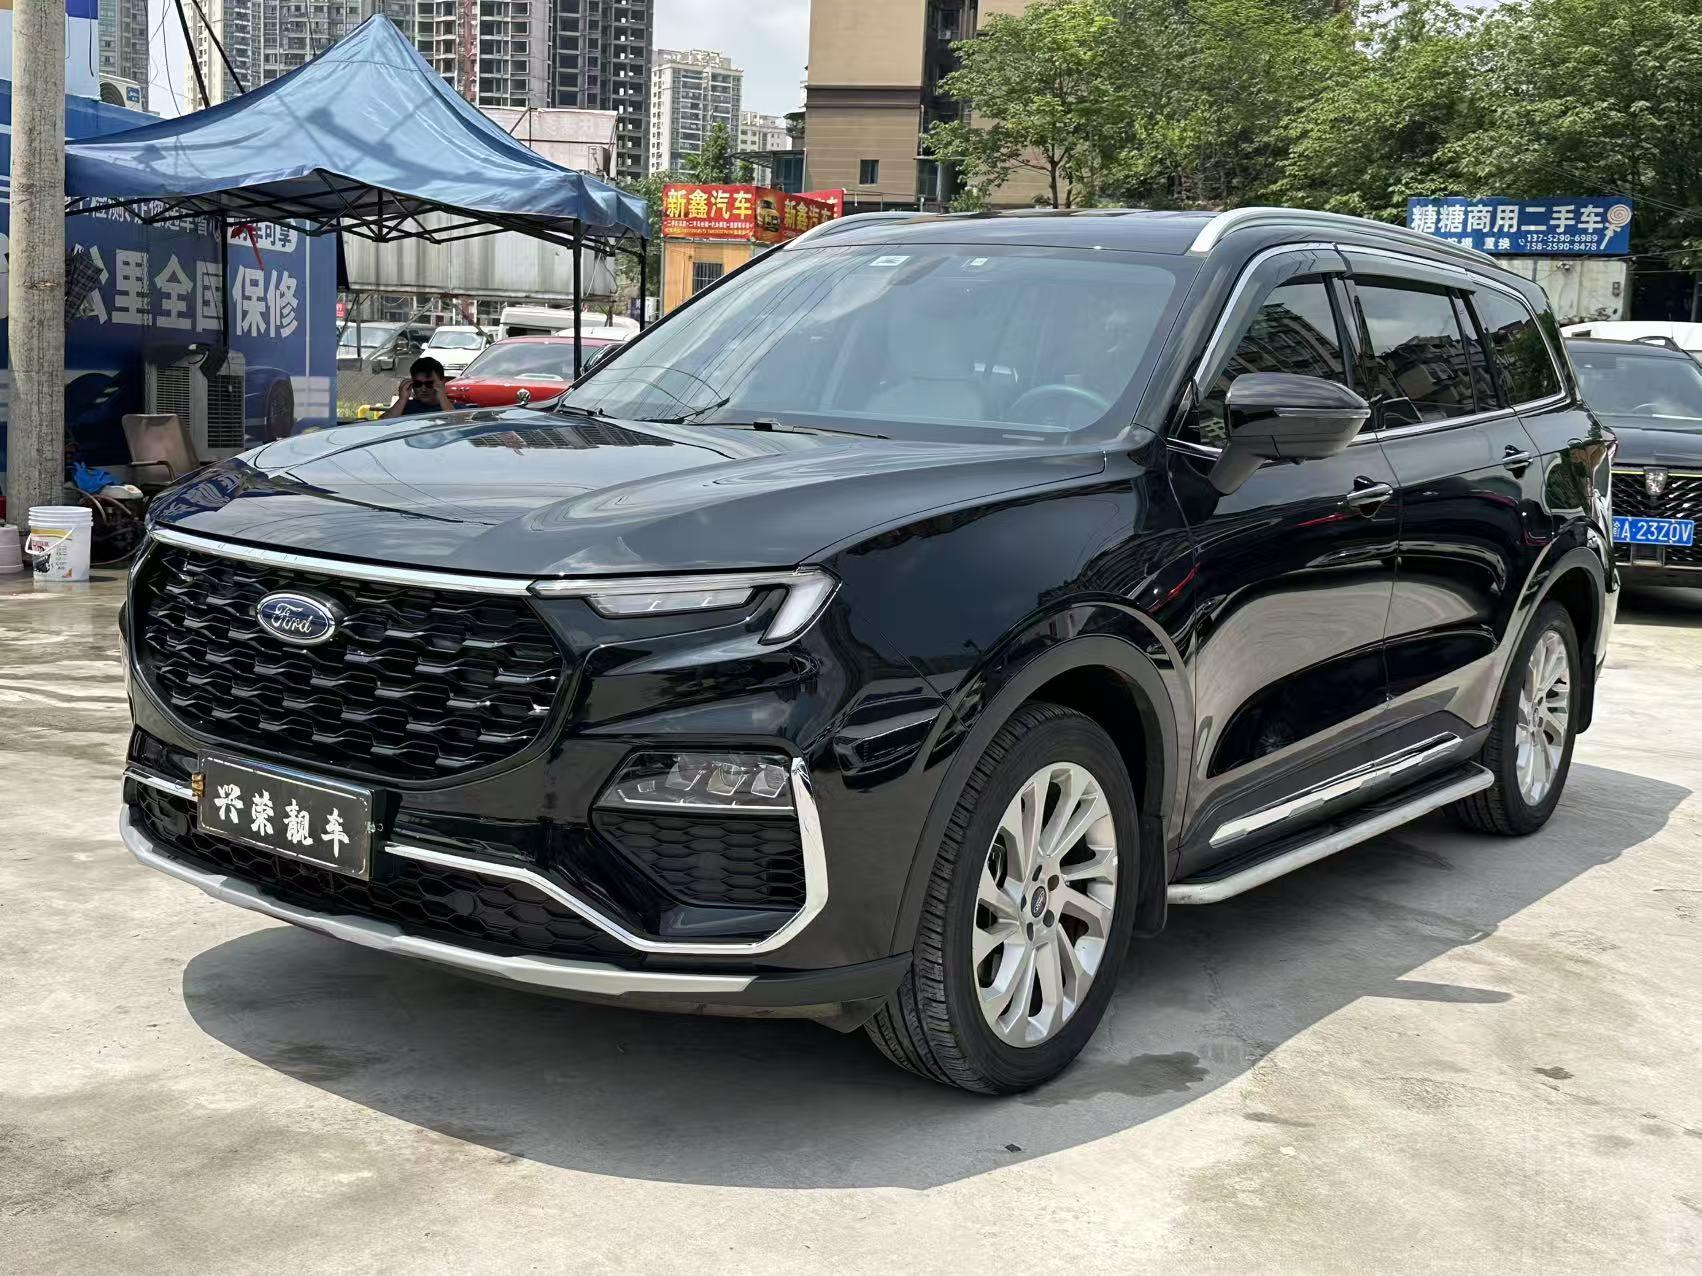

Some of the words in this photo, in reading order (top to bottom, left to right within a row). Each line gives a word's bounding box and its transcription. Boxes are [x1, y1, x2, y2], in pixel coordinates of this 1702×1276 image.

[667, 190, 752, 219] 新鑫汽车
[1410, 204, 1604, 233] 糖糖商用二手车
[1483, 237, 1511, 250] 置换
[271, 603, 314, 634] Ford
[214, 783, 350, 858] 兴荣靓车
